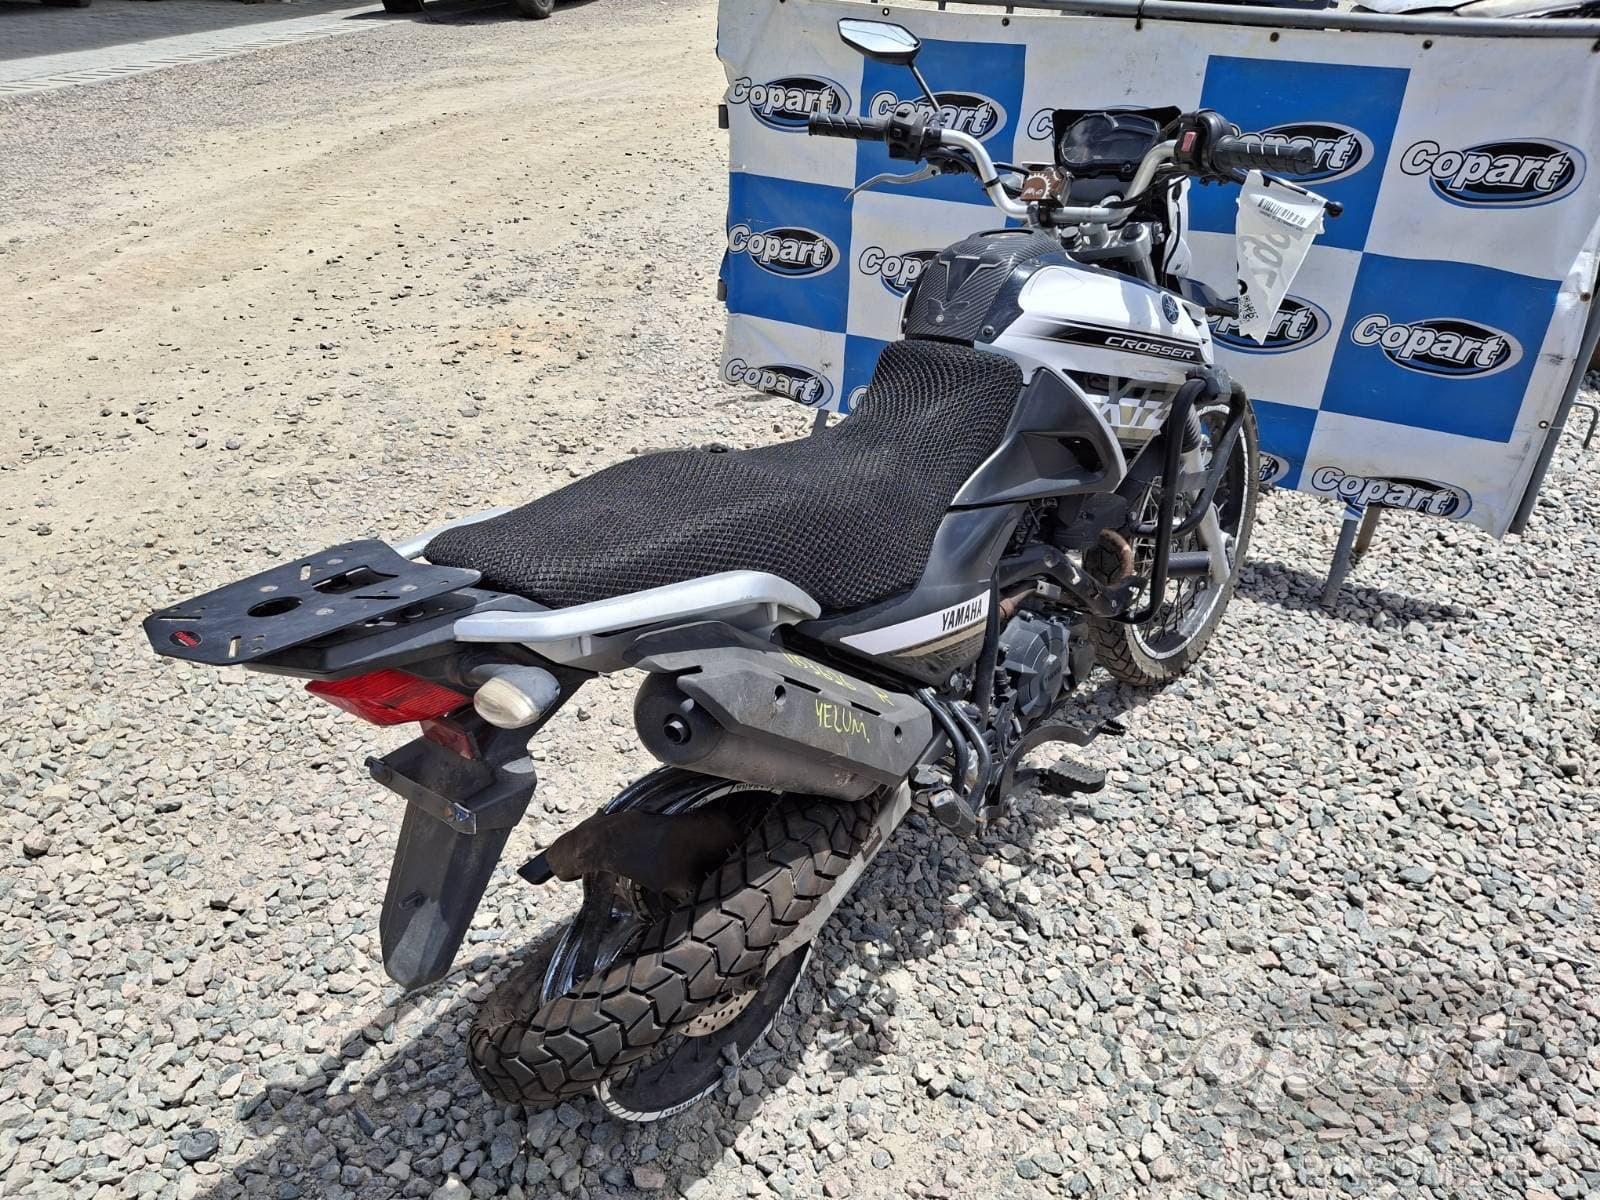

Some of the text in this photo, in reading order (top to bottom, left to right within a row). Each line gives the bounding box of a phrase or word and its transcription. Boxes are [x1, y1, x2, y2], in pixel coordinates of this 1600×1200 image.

[728, 77, 835, 116] Copart
[1399, 140, 1568, 191] Copart
[728, 224, 830, 267] Copart
[1104, 335, 1195, 360] CROSSER
[1352, 314, 1503, 367] Copart
[725, 358, 825, 403] Copart
[1312, 466, 1459, 516] Copart
[941, 597, 982, 632] YAMAHA
